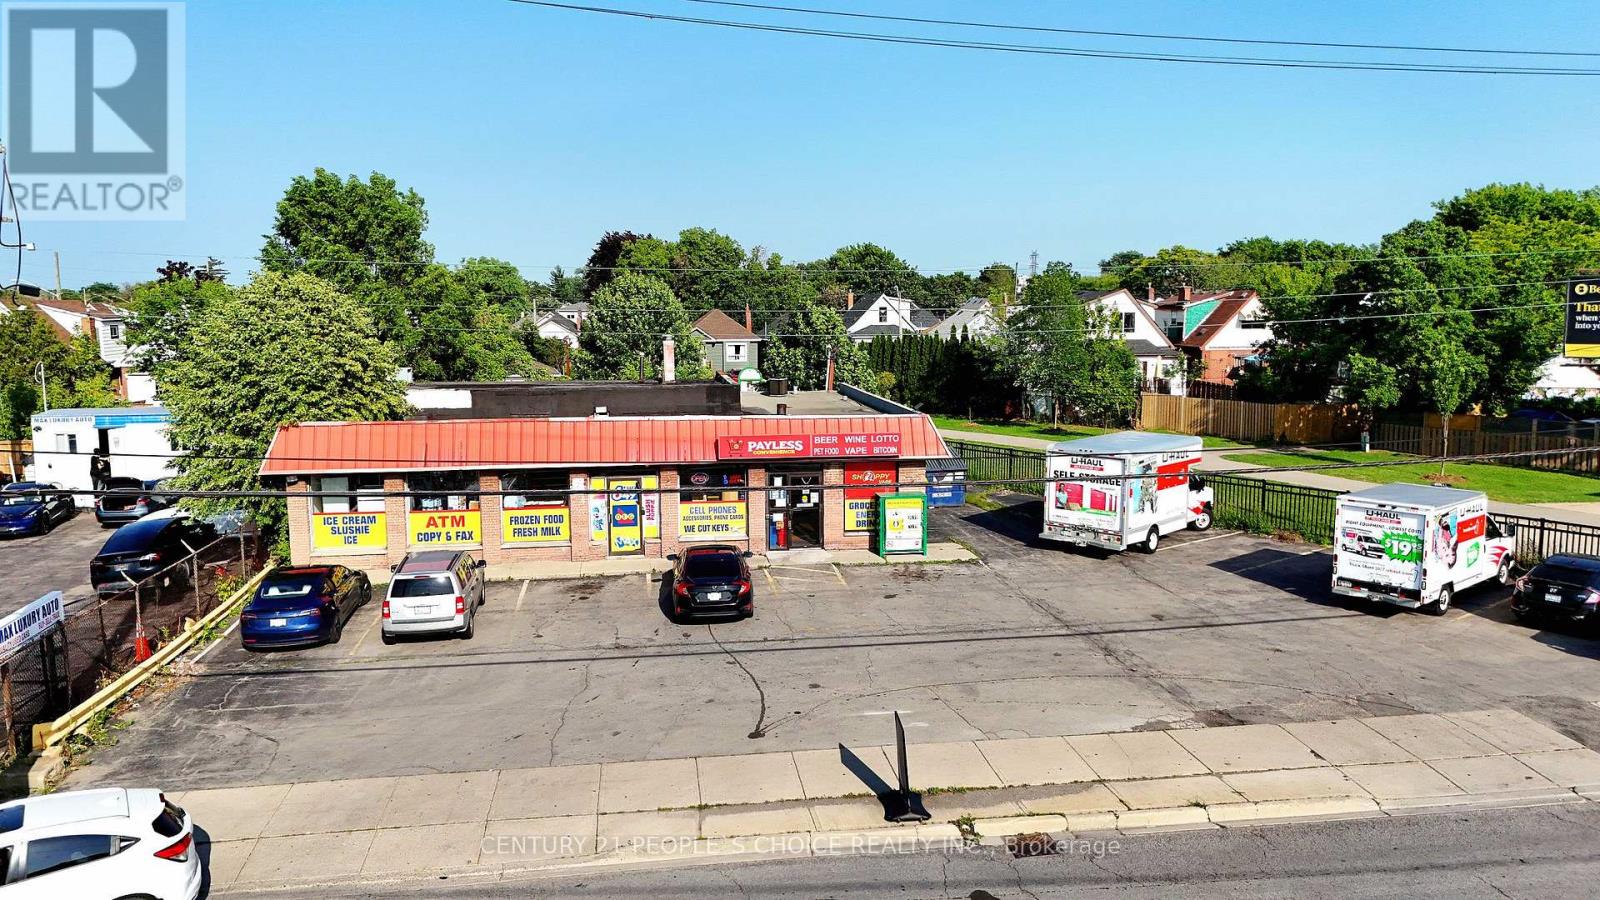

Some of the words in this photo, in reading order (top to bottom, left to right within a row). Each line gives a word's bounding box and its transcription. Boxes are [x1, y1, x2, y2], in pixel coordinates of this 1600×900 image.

[1575, 314, 1598, 322] when
[1575, 321, 1591, 329] into
[814, 435, 838, 444] BEER
[844, 435, 867, 443] WINE
[870, 434, 900, 443] LOTTO
[747, 440, 804, 454] PAYLESS
[813, 447, 824, 456] PET
[824, 447, 840, 456] FOOD
[844, 446, 867, 455] VAPE
[873, 446, 898, 454] BITCOIN
[1070, 457, 1104, 467] U-HAUL
[689, 506, 706, 515] CELL
[708, 505, 737, 515] PHONES
[849, 501, 875, 510] GROCE
[509, 515, 541, 526] FROZEN
[543, 514, 564, 524] FOOD
[1366, 510, 1401, 520] U-HAUL
[323, 516, 338, 526] ICE
[342, 515, 376, 525] CREAM
[425, 515, 465, 529] ATM
[330, 525, 370, 535] SLUSHIE
[512, 527, 538, 537] FRESH
[540, 526, 561, 536] MILK
[684, 524, 696, 533] WE
[697, 524, 711, 533] CUT
[711, 523, 729, 532] KEYS
[344, 535, 358, 545] ICE
[417, 531, 442, 542] COPY
[445, 531, 452, 542] &
[455, 530, 474, 541] FAX
[14, 608, 41, 635] LUXURY
[42, 598, 59, 619] AUTO
